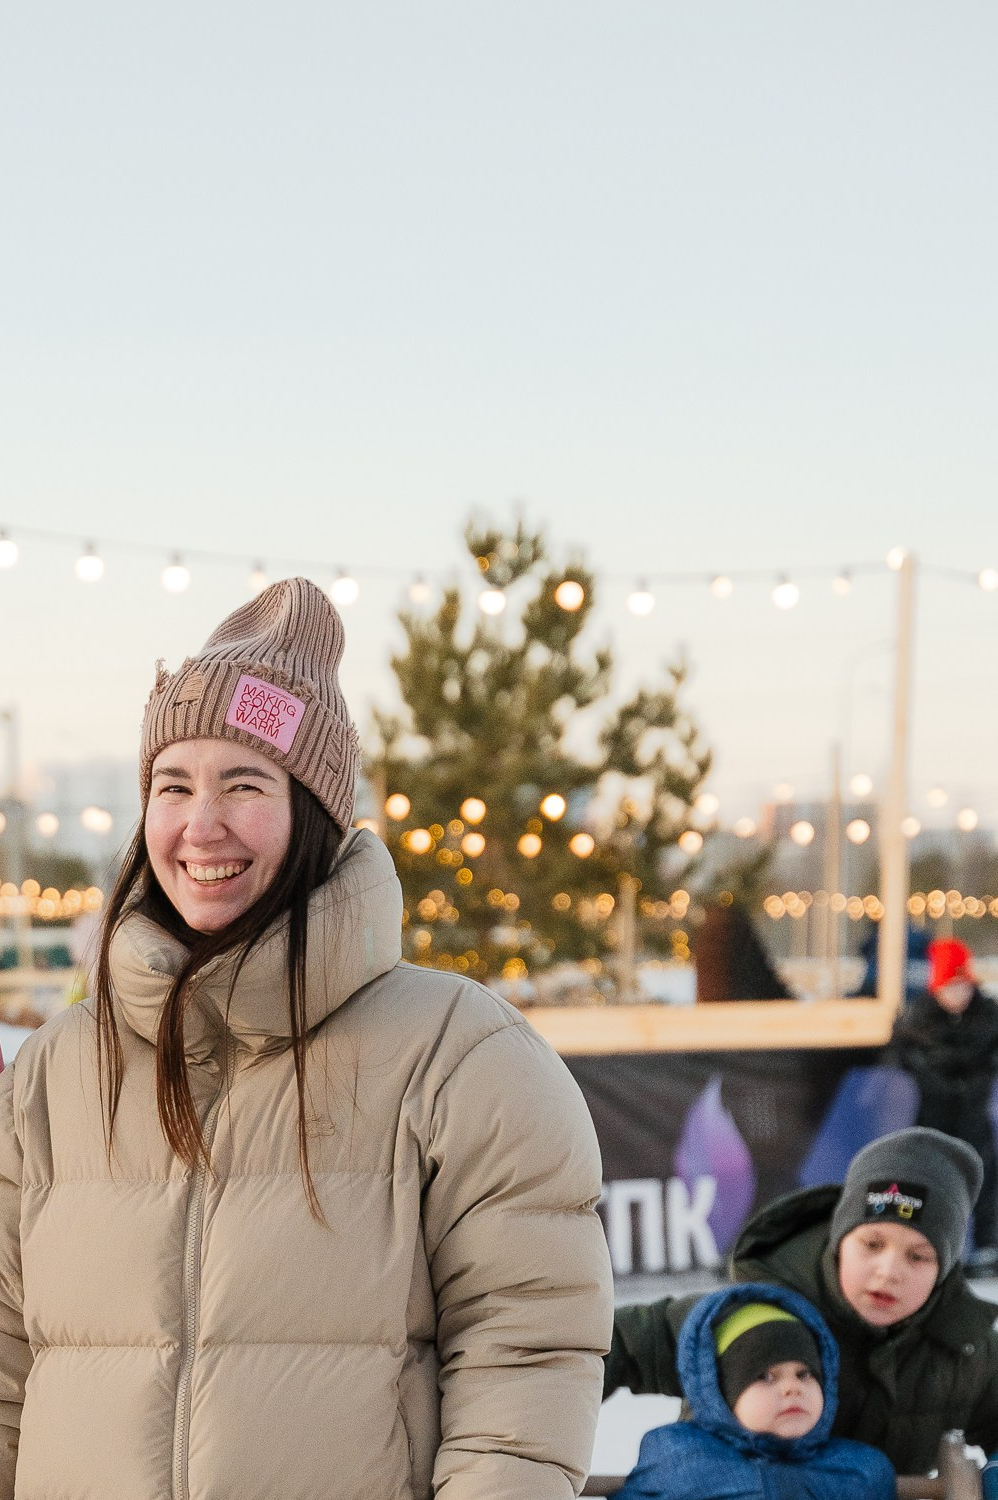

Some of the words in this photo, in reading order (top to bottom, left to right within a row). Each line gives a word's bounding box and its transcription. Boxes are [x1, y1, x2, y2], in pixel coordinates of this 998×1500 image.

[237, 701, 286, 729] STORY
[241, 692, 280, 717] COLD
[236, 709, 279, 739] WARM
[599, 1177, 719, 1274] ПК
